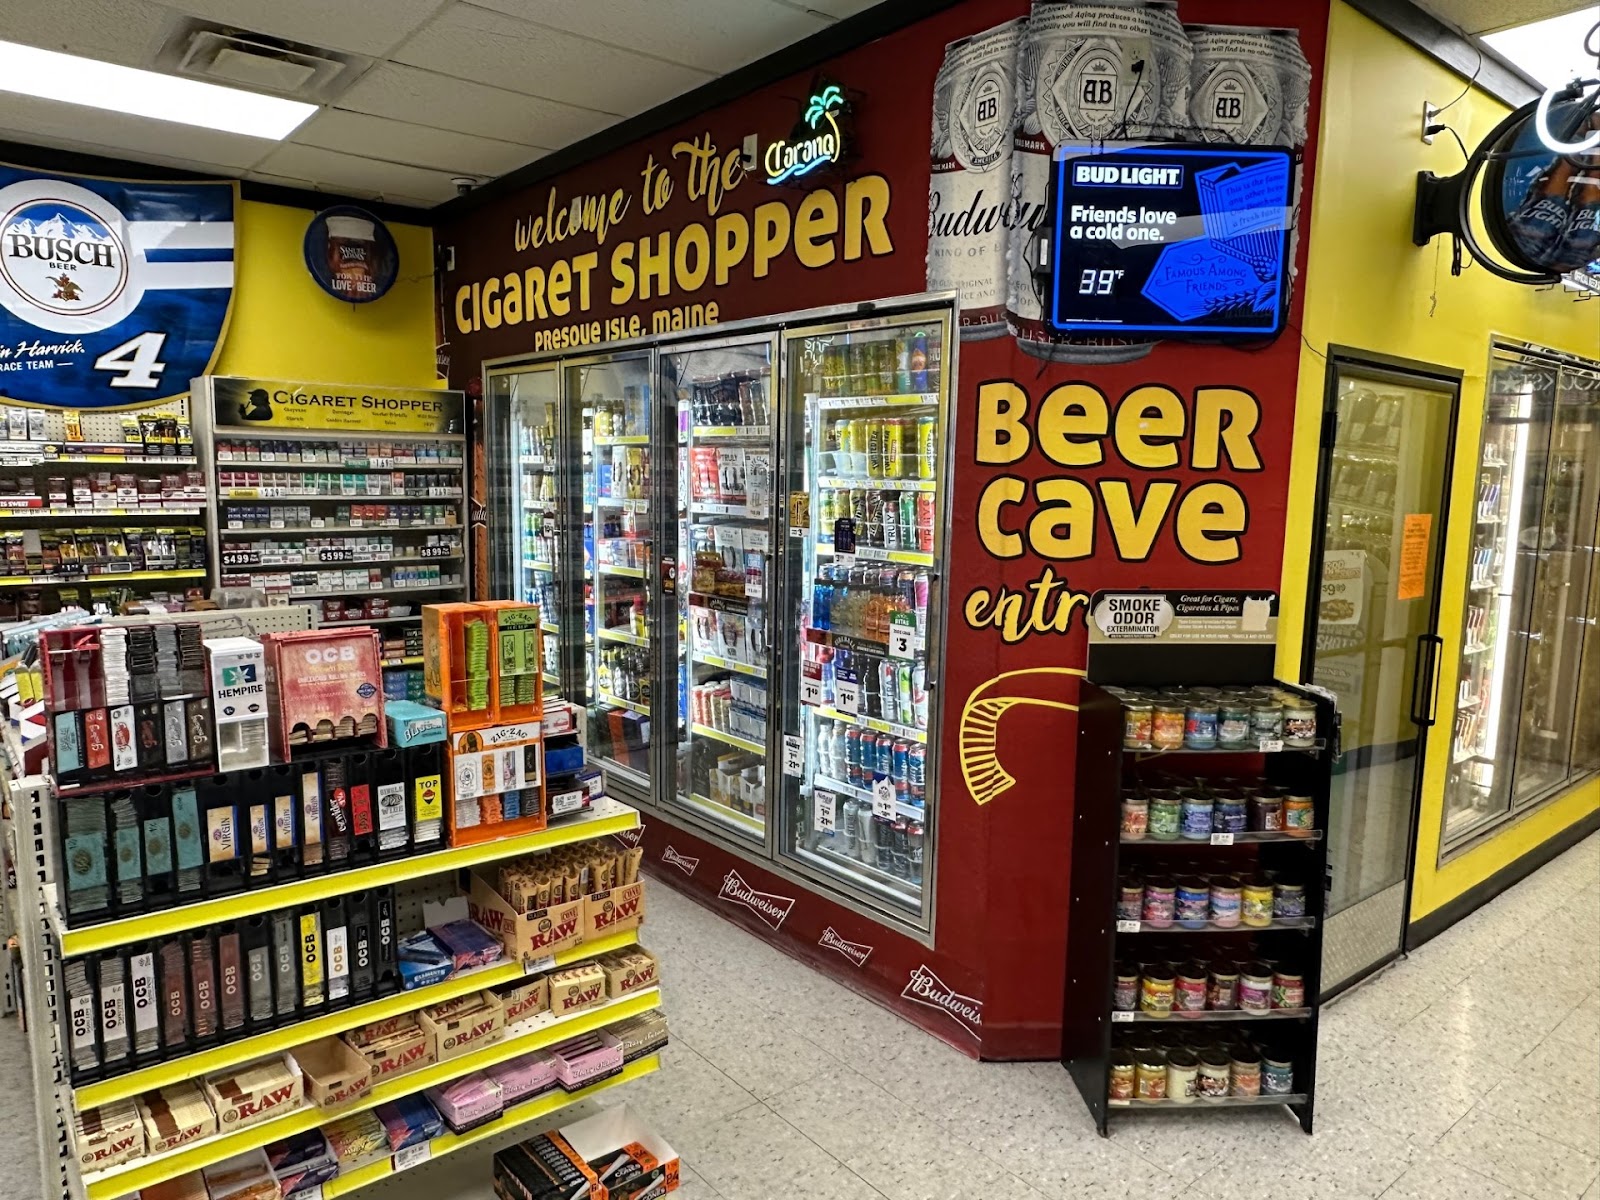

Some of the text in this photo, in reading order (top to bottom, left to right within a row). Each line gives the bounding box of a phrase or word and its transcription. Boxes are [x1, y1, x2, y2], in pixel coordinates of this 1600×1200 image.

[1063, 21, 1075, 29] you
[1092, 20, 1107, 28] find
[1129, 25, 1147, 34] other
[1098, 12, 1130, 21] produces
[1224, 45, 1238, 53] find
[1083, 79, 1113, 105] AB
[977, 97, 998, 122] AB
[1215, 97, 1241, 119] AB
[1076, 166, 1180, 185] BUD LIGHT
[515, 187, 633, 251] welcome
[641, 154, 674, 215] to
[1070, 205, 1177, 224] Friends love
[1533, 199, 1567, 220] BUD
[1070, 223, 1165, 241] a cold one.
[7, 233, 115, 269] BUSCH
[49, 261, 77, 272] BEER
[332, 279, 376, 293] LOVE BEER
[26, 359, 54, 370] TEAM
[94, 332, 167, 388] 4
[361, 395, 444, 413] SHOPPER
[888, 512, 897, 545] TRULY
[1109, 598, 1161, 612] SMOKE
[1176, 604, 1240, 614] Cigarettes & Pipes
[1180, 595, 1239, 605] Great for Cigars,
[1106, 625, 1160, 633] EXTERMINATOR
[1113, 612, 1155, 625] ODOR
[306, 646, 355, 665] OCB
[218, 684, 264, 699] HEMPIRE
[490, 727, 528, 743] ZIG-ZAG
[419, 779, 438, 789] TOP
[310, 796, 319, 821] VIRGIN
[220, 817, 232, 851] VIRGIN
[282, 808, 291, 836] VIRGIN
[664, 848, 695, 871] Budweiser
[723, 874, 788, 922] Budweiser
[594, 896, 641, 930] RAW
[380, 917, 391, 945] OCB
[530, 917, 579, 951] RAW
[305, 932, 317, 963] OCB
[358, 939, 369, 967] OCB
[822, 928, 868, 961] Budweiser
[252, 953, 263, 982] OCB
[279, 944, 291, 973] OCB
[333, 944, 343, 973] OCB
[134, 976, 148, 1009] OCB
[225, 965, 237, 995] OCB
[620, 967, 655, 992] RAW
[170, 990, 181, 1016] OCB
[199, 980, 211, 1010] OCB
[506, 992, 542, 1019] RAW
[562, 986, 601, 1010] RAW
[74, 1008, 87, 1037] OCB
[104, 998, 118, 1030] OCB
[363, 1018, 399, 1042] RAW
[455, 1018, 495, 1046] RAW
[379, 1042, 427, 1075] RAW
[335, 1075, 368, 1101] RAW
[237, 1082, 295, 1121] RAW
[93, 1136, 136, 1162] RAW
[165, 1124, 202, 1149] RAW
